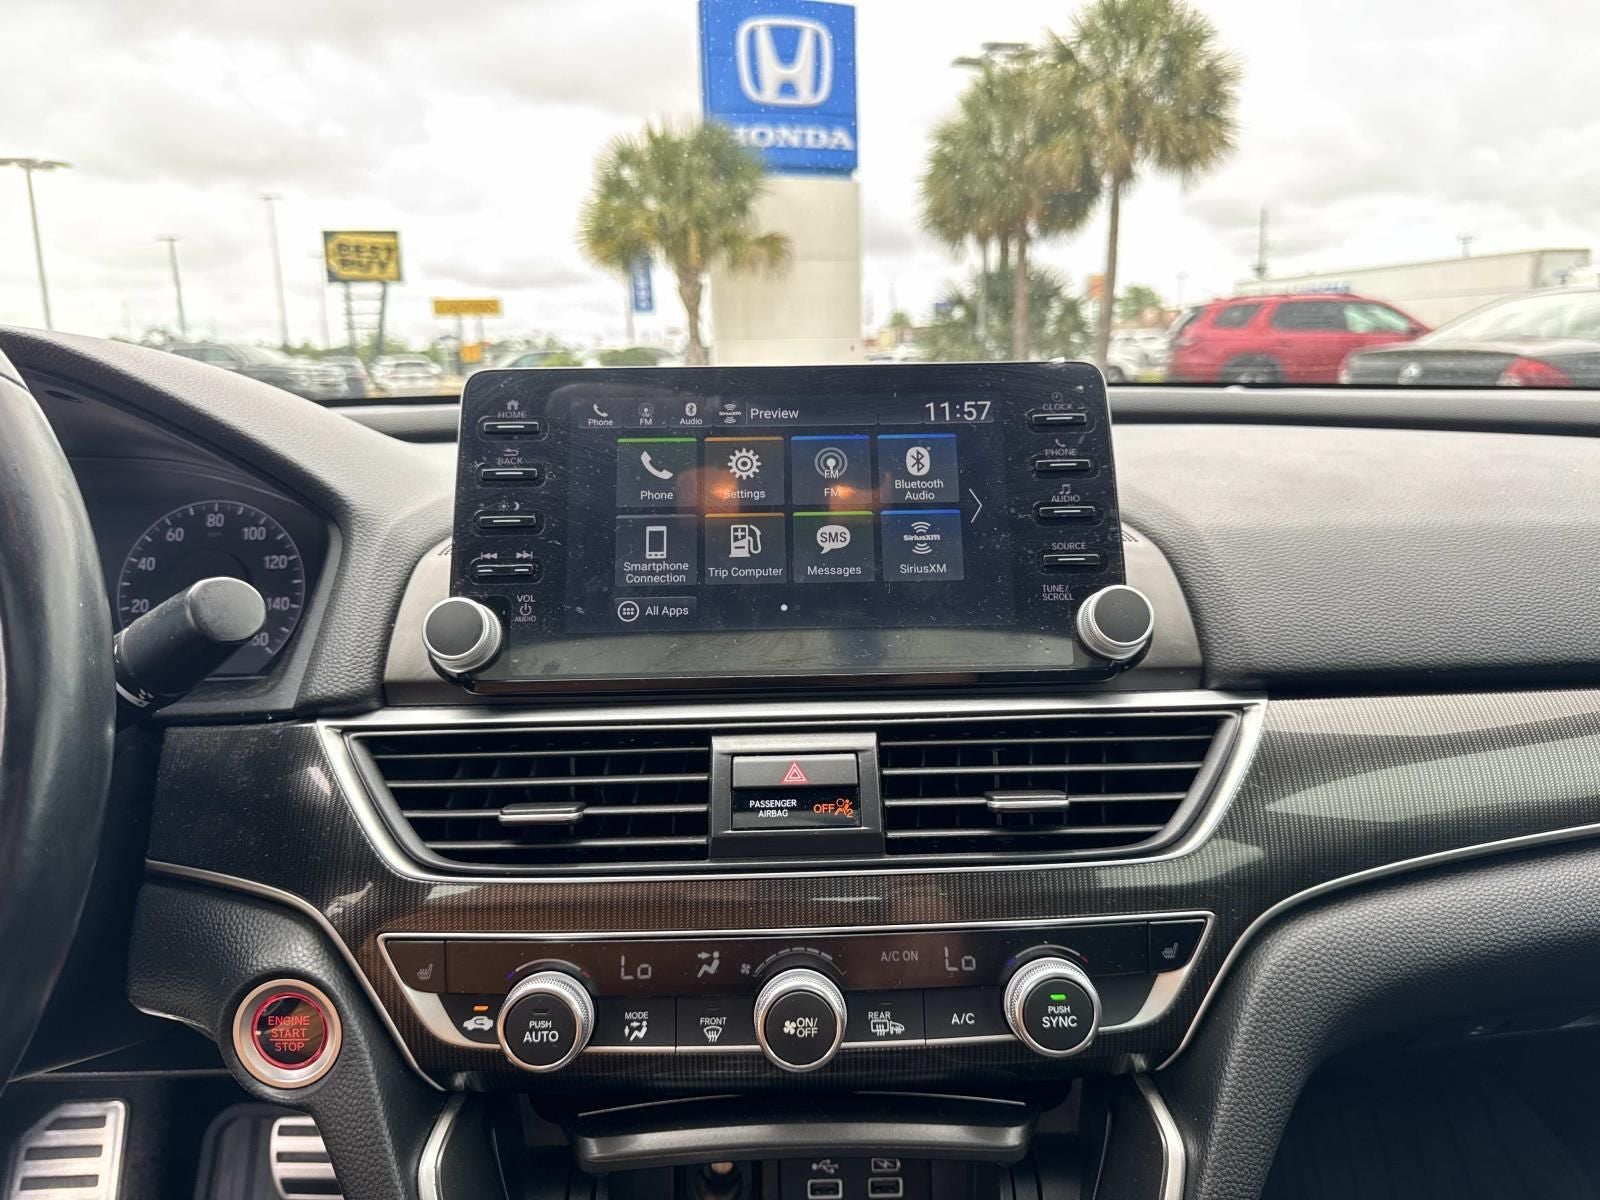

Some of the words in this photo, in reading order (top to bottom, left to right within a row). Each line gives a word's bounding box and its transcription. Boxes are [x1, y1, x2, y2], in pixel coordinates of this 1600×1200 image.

[924, 401, 992, 421] 11:57
[1042, 402, 1072, 411] CLOCK
[497, 411, 527, 419] HOME
[749, 406, 800, 421] Preview
[588, 418, 613, 427] Phone
[680, 418, 703, 426] Audio
[1045, 448, 1077, 457] PHONE
[497, 457, 523, 465] BACK
[894, 478, 944, 490] Bluetooth
[640, 489, 674, 501] Phone
[724, 488, 766, 502] Settings
[823, 487, 840, 498] FM
[904, 490, 935, 501] Audio
[1051, 495, 1081, 503] AUDIO
[206, 513, 225, 528] 80
[166, 527, 185, 542] 60
[242, 526, 266, 541] 100
[819, 531, 848, 543] SMS
[1051, 542, 1087, 551] SOURCE
[137, 556, 156, 571] 40
[263, 555, 288, 570] 120
[623, 560, 689, 575] Smartphone
[708, 566, 728, 579] Trip
[729, 566, 784, 579] Computer
[807, 564, 862, 578] Messages
[899, 563, 947, 574] SiriusXM
[625, 572, 686, 584] Connection
[1042, 584, 1069, 593] TUNE/
[516, 594, 536, 603] VOL
[1042, 592, 1074, 601] SCROLL
[131, 598, 149, 613] 20
[266, 596, 290, 611] 140
[645, 605, 659, 616] All
[660, 605, 689, 619] Apps
[514, 615, 537, 623] AUDIO
[749, 799, 797, 809] PASSENGER
[813, 803, 836, 814] OFF
[758, 809, 789, 818] AIRBAG
[880, 950, 900, 963] A/C
[901, 950, 919, 962] ON
[944, 947, 977, 972] Lo
[620, 955, 652, 981] Lo
[624, 1011, 649, 1020] MODE
[868, 1011, 891, 1020] REAR
[1047, 1006, 1071, 1015] PUSH
[267, 1015, 311, 1026] ENGINE
[699, 1016, 728, 1025] FRONT
[796, 1017, 818, 1028] ON/
[951, 1012, 976, 1025] A/C
[1041, 1015, 1078, 1028] SYNC
[529, 1020, 552, 1029] PUSH
[271, 1028, 308, 1039] START
[523, 1031, 560, 1043] AUTO
[796, 1028, 819, 1038] OFF
[274, 1042, 305, 1052] STOP
